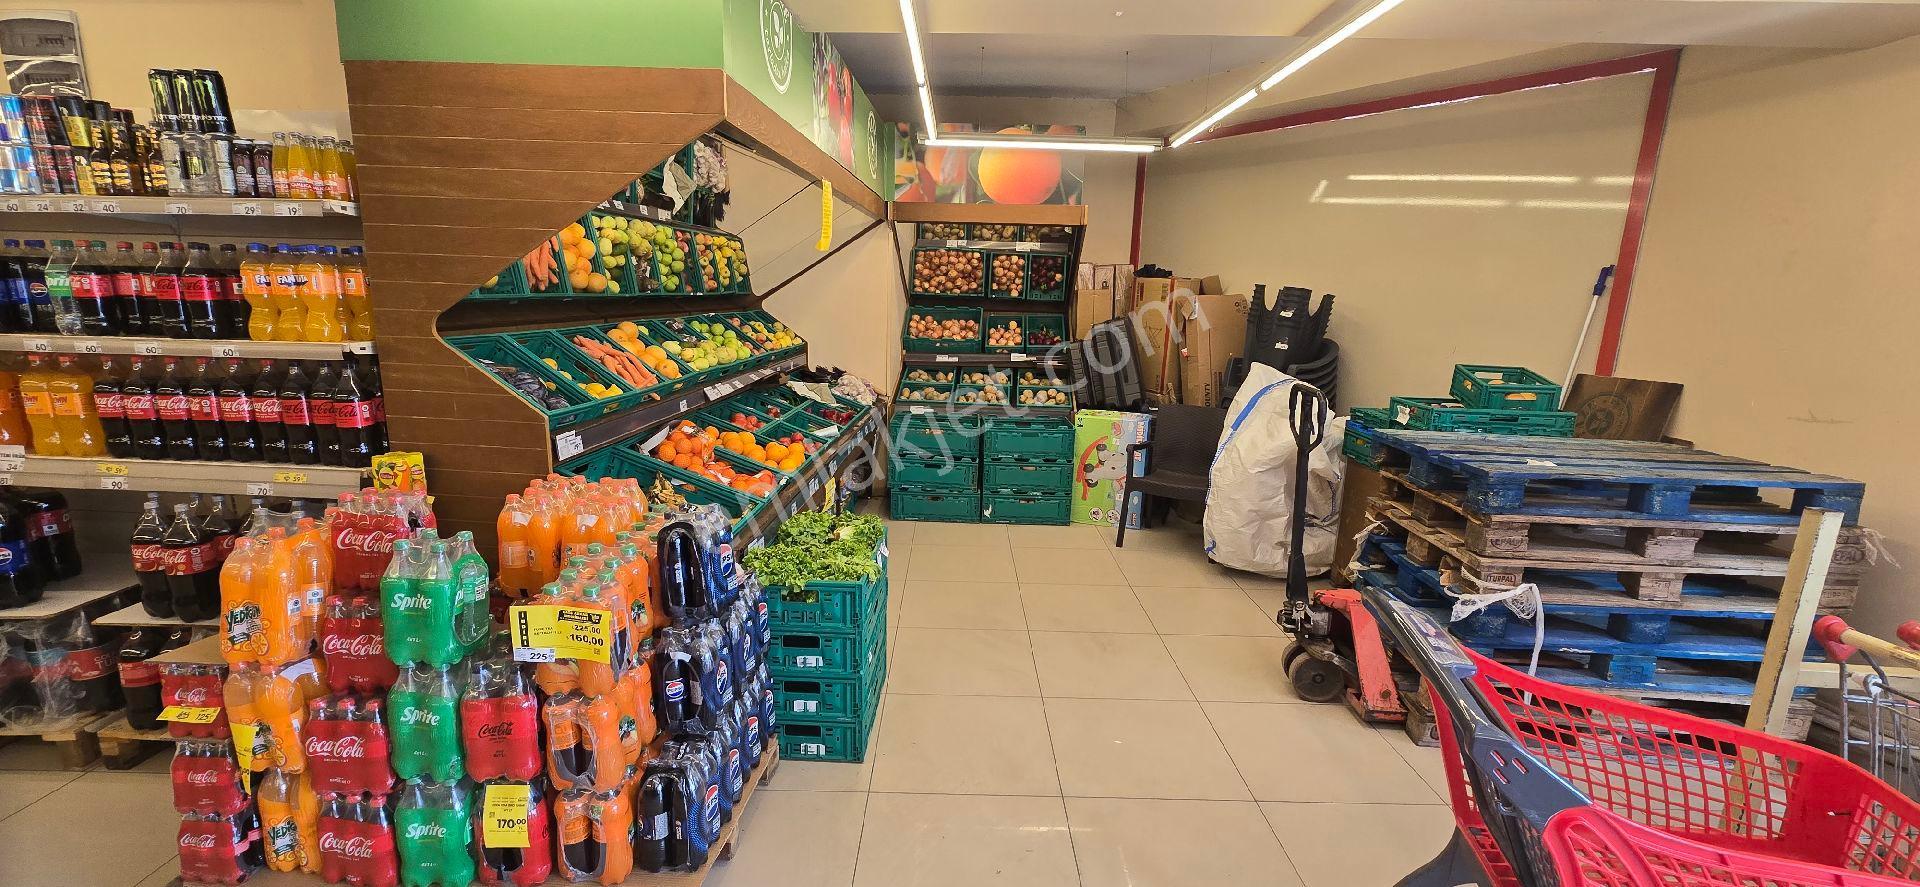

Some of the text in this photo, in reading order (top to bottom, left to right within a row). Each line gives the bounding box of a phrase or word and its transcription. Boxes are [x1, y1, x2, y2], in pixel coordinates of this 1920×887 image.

[37, 203, 49, 212] 24
[73, 203, 85, 212] 32
[102, 204, 115, 213] 40
[175, 206, 187, 214] 70
[244, 206, 256, 215] 29
[287, 207, 298, 216] 19
[35, 343, 47, 351] 60
[85, 345, 97, 353] 60
[145, 346, 157, 354] 60
[222, 348, 234, 357] 60
[111, 481, 122, 490] 90
[257, 487, 268, 496] 70
[336, 527, 397, 554] Coca-Cola
[391, 593, 432, 611] Sprite
[322, 634, 384, 656] Coca-Cola
[529, 652, 548, 661] 225
[400, 706, 441, 726] Sprite
[305, 735, 366, 758] Coca-Cola
[187, 769, 218, 784] Coca-Cola
[405, 822, 447, 838] Sprite
[180, 832, 217, 849] Coca-Cola
[319, 831, 376, 859] Coca-Cola
